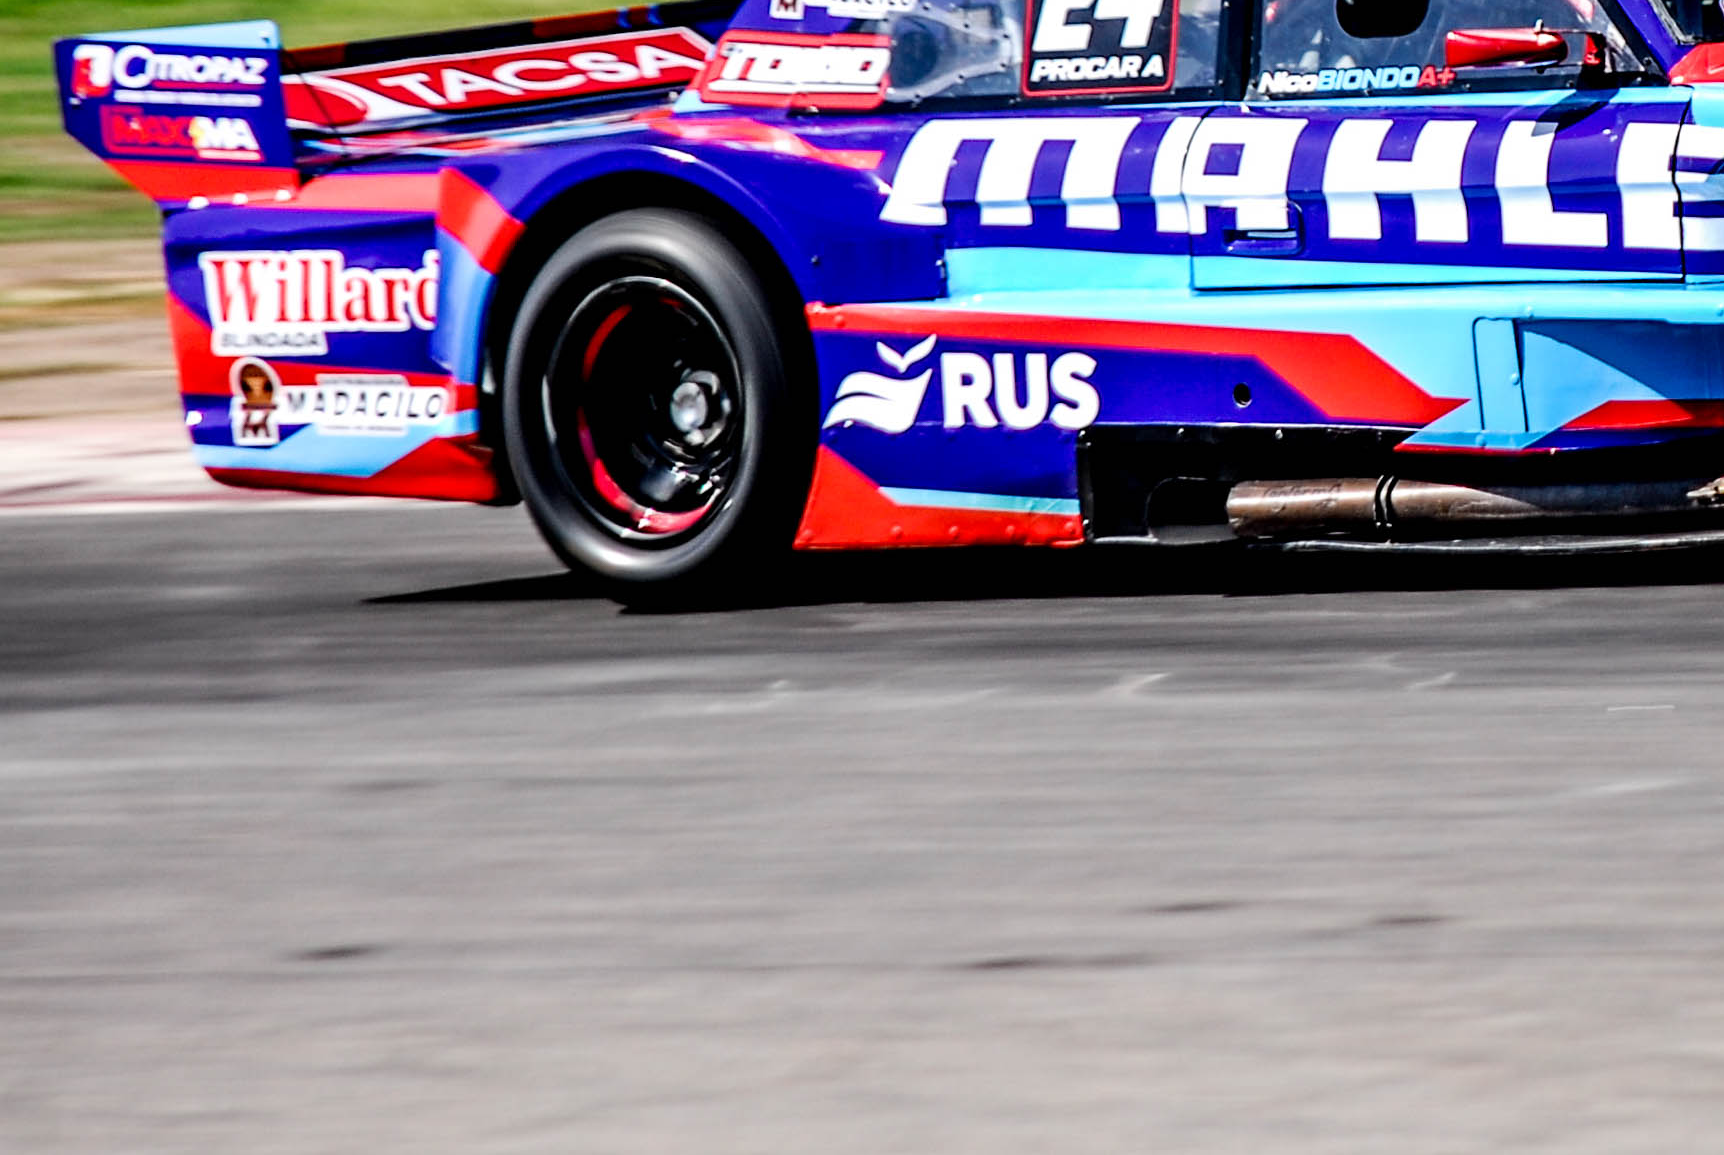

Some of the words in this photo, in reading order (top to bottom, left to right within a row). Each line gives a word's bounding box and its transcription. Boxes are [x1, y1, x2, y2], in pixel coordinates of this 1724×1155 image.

[378, 45, 706, 106] TACSA
[1030, 55, 1143, 82] PROCAR
[1141, 54, 1164, 77] A
[287, 392, 443, 419] MADACILO
[942, 351, 1100, 431] RUS
